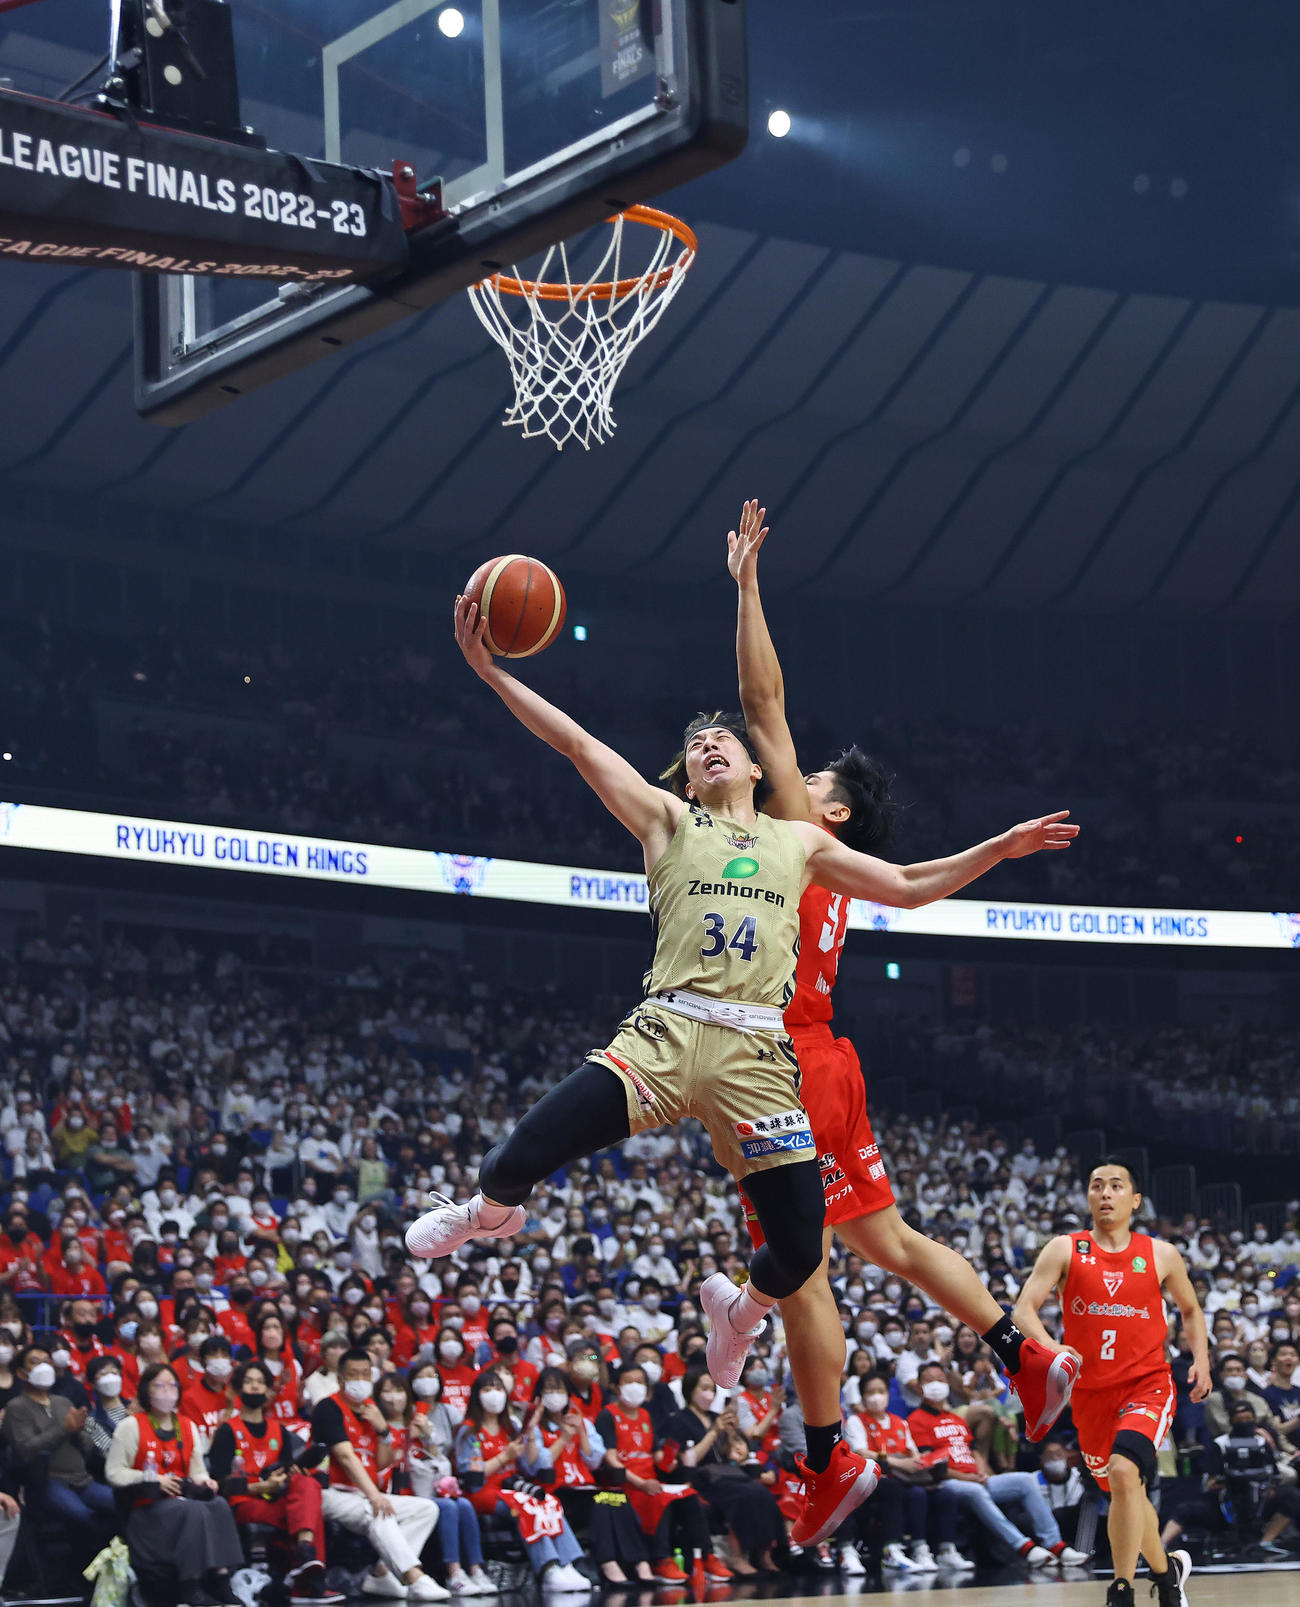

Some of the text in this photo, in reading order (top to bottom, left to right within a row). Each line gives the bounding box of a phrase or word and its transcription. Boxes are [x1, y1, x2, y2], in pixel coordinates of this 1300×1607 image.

[0, 128, 367, 237] LEAGUE FINALS 2022-23
[96, 247, 217, 273] FINALS
[115, 824, 368, 875] RYUKYU GOLDEN KINGS
[569, 874, 646, 904] RYUKYU
[687, 879, 785, 909] Zenhoren
[700, 912, 759, 963] 34
[986, 907, 1208, 938] RYUKYU GOLDEN KINGS
[626, 1067, 654, 1101] DAIHATSU
[754, 1112, 805, 1133] 琉球銀行
[746, 1132, 814, 1155] 沖縄タイムス
[822, 1167, 846, 1190] AL
[1100, 1329, 1117, 1360] 2
